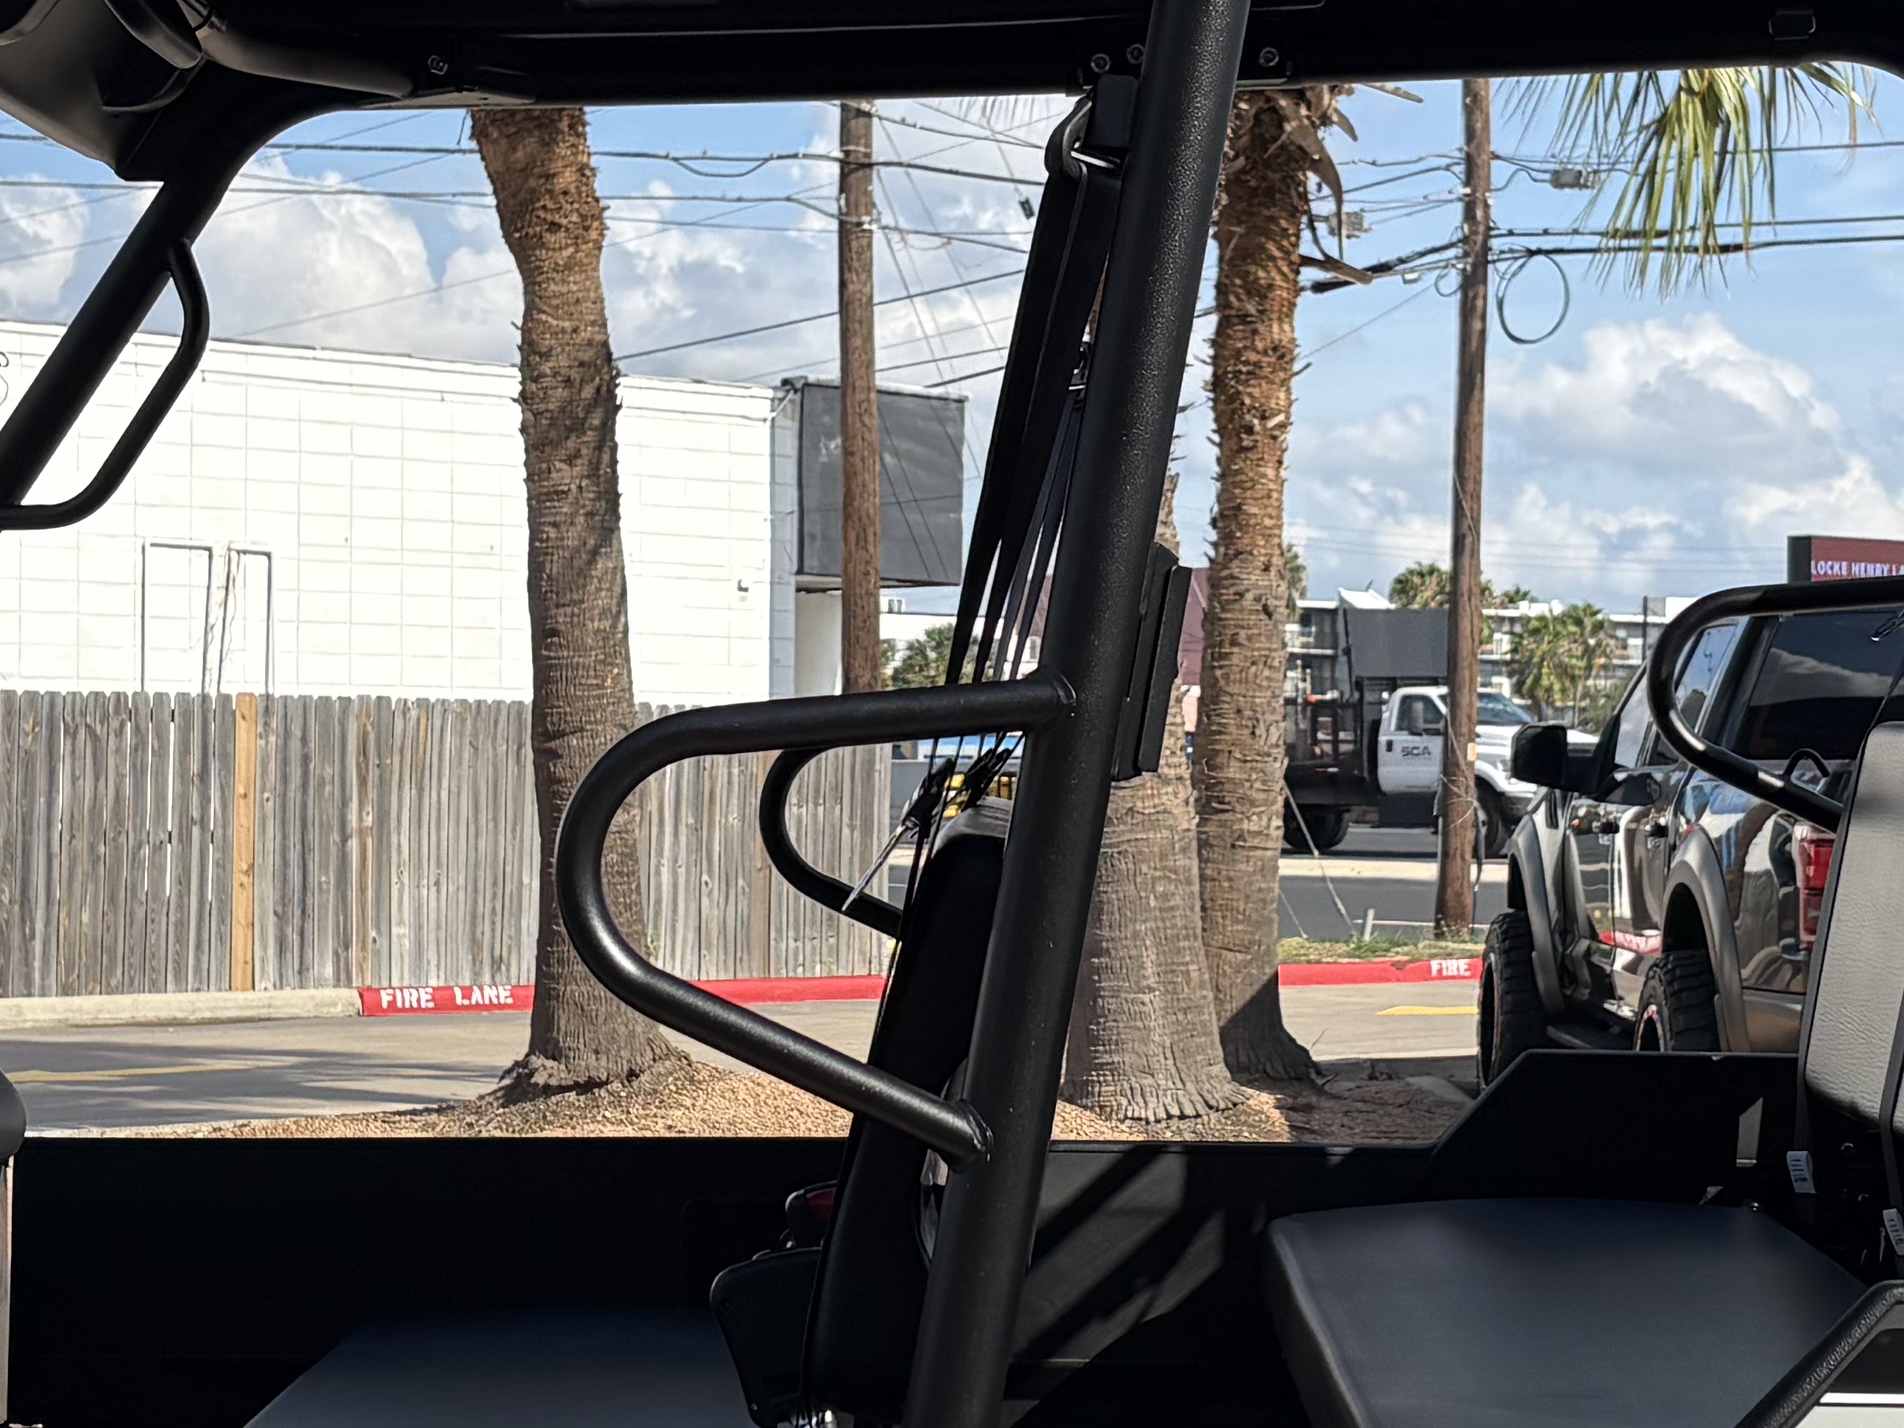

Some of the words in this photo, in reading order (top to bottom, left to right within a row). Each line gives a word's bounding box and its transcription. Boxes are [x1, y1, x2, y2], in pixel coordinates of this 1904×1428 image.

[1811, 560, 1847, 576] LOCKE
[1852, 562, 1890, 577] HENRY
[1430, 959, 1472, 977] FIRE
[380, 987, 435, 1009] FIRE
[454, 985, 514, 1006] LANE
